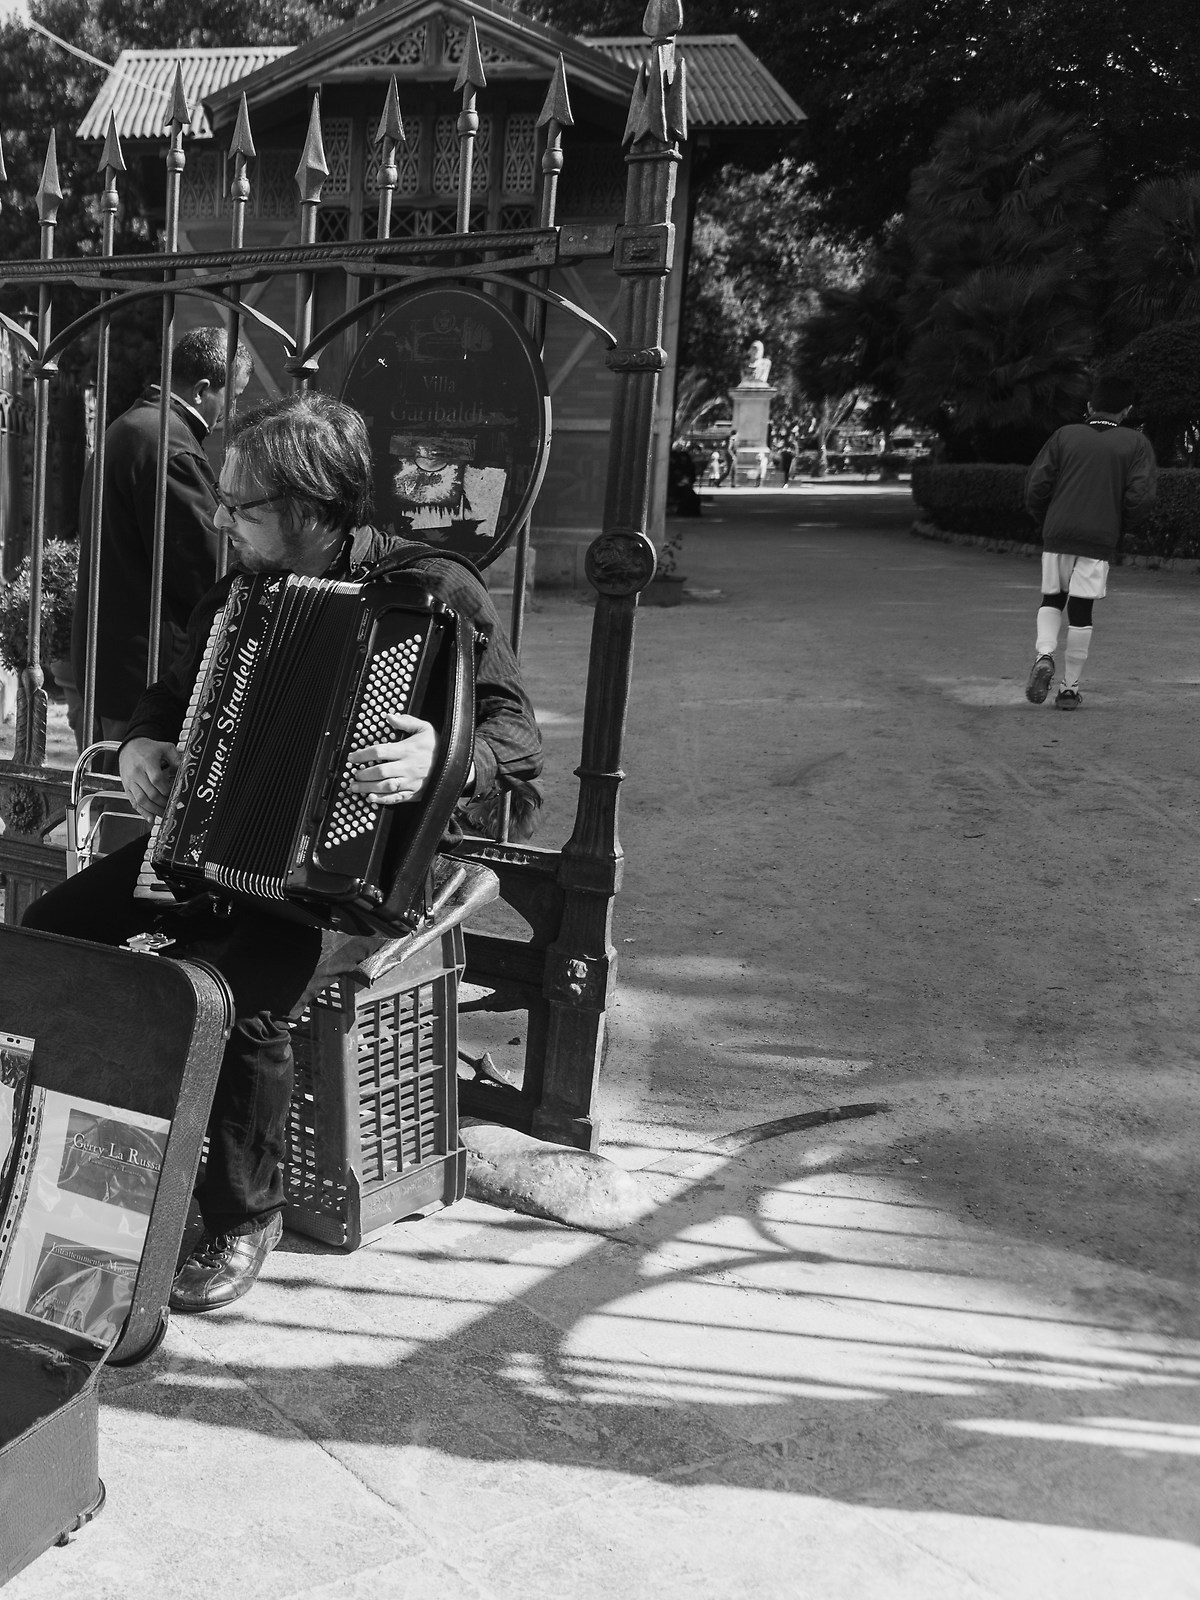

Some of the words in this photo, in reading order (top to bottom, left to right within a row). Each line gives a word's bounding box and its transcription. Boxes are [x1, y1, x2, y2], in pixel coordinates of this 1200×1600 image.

[423, 375, 456, 393] Villa
[389, 400, 484, 422] Garibaldi
[196, 738, 228, 803] Super
[216, 637, 259, 734] Stradella
[72, 1132, 105, 1159] Gerry
[108, 1142, 124, 1161] La
